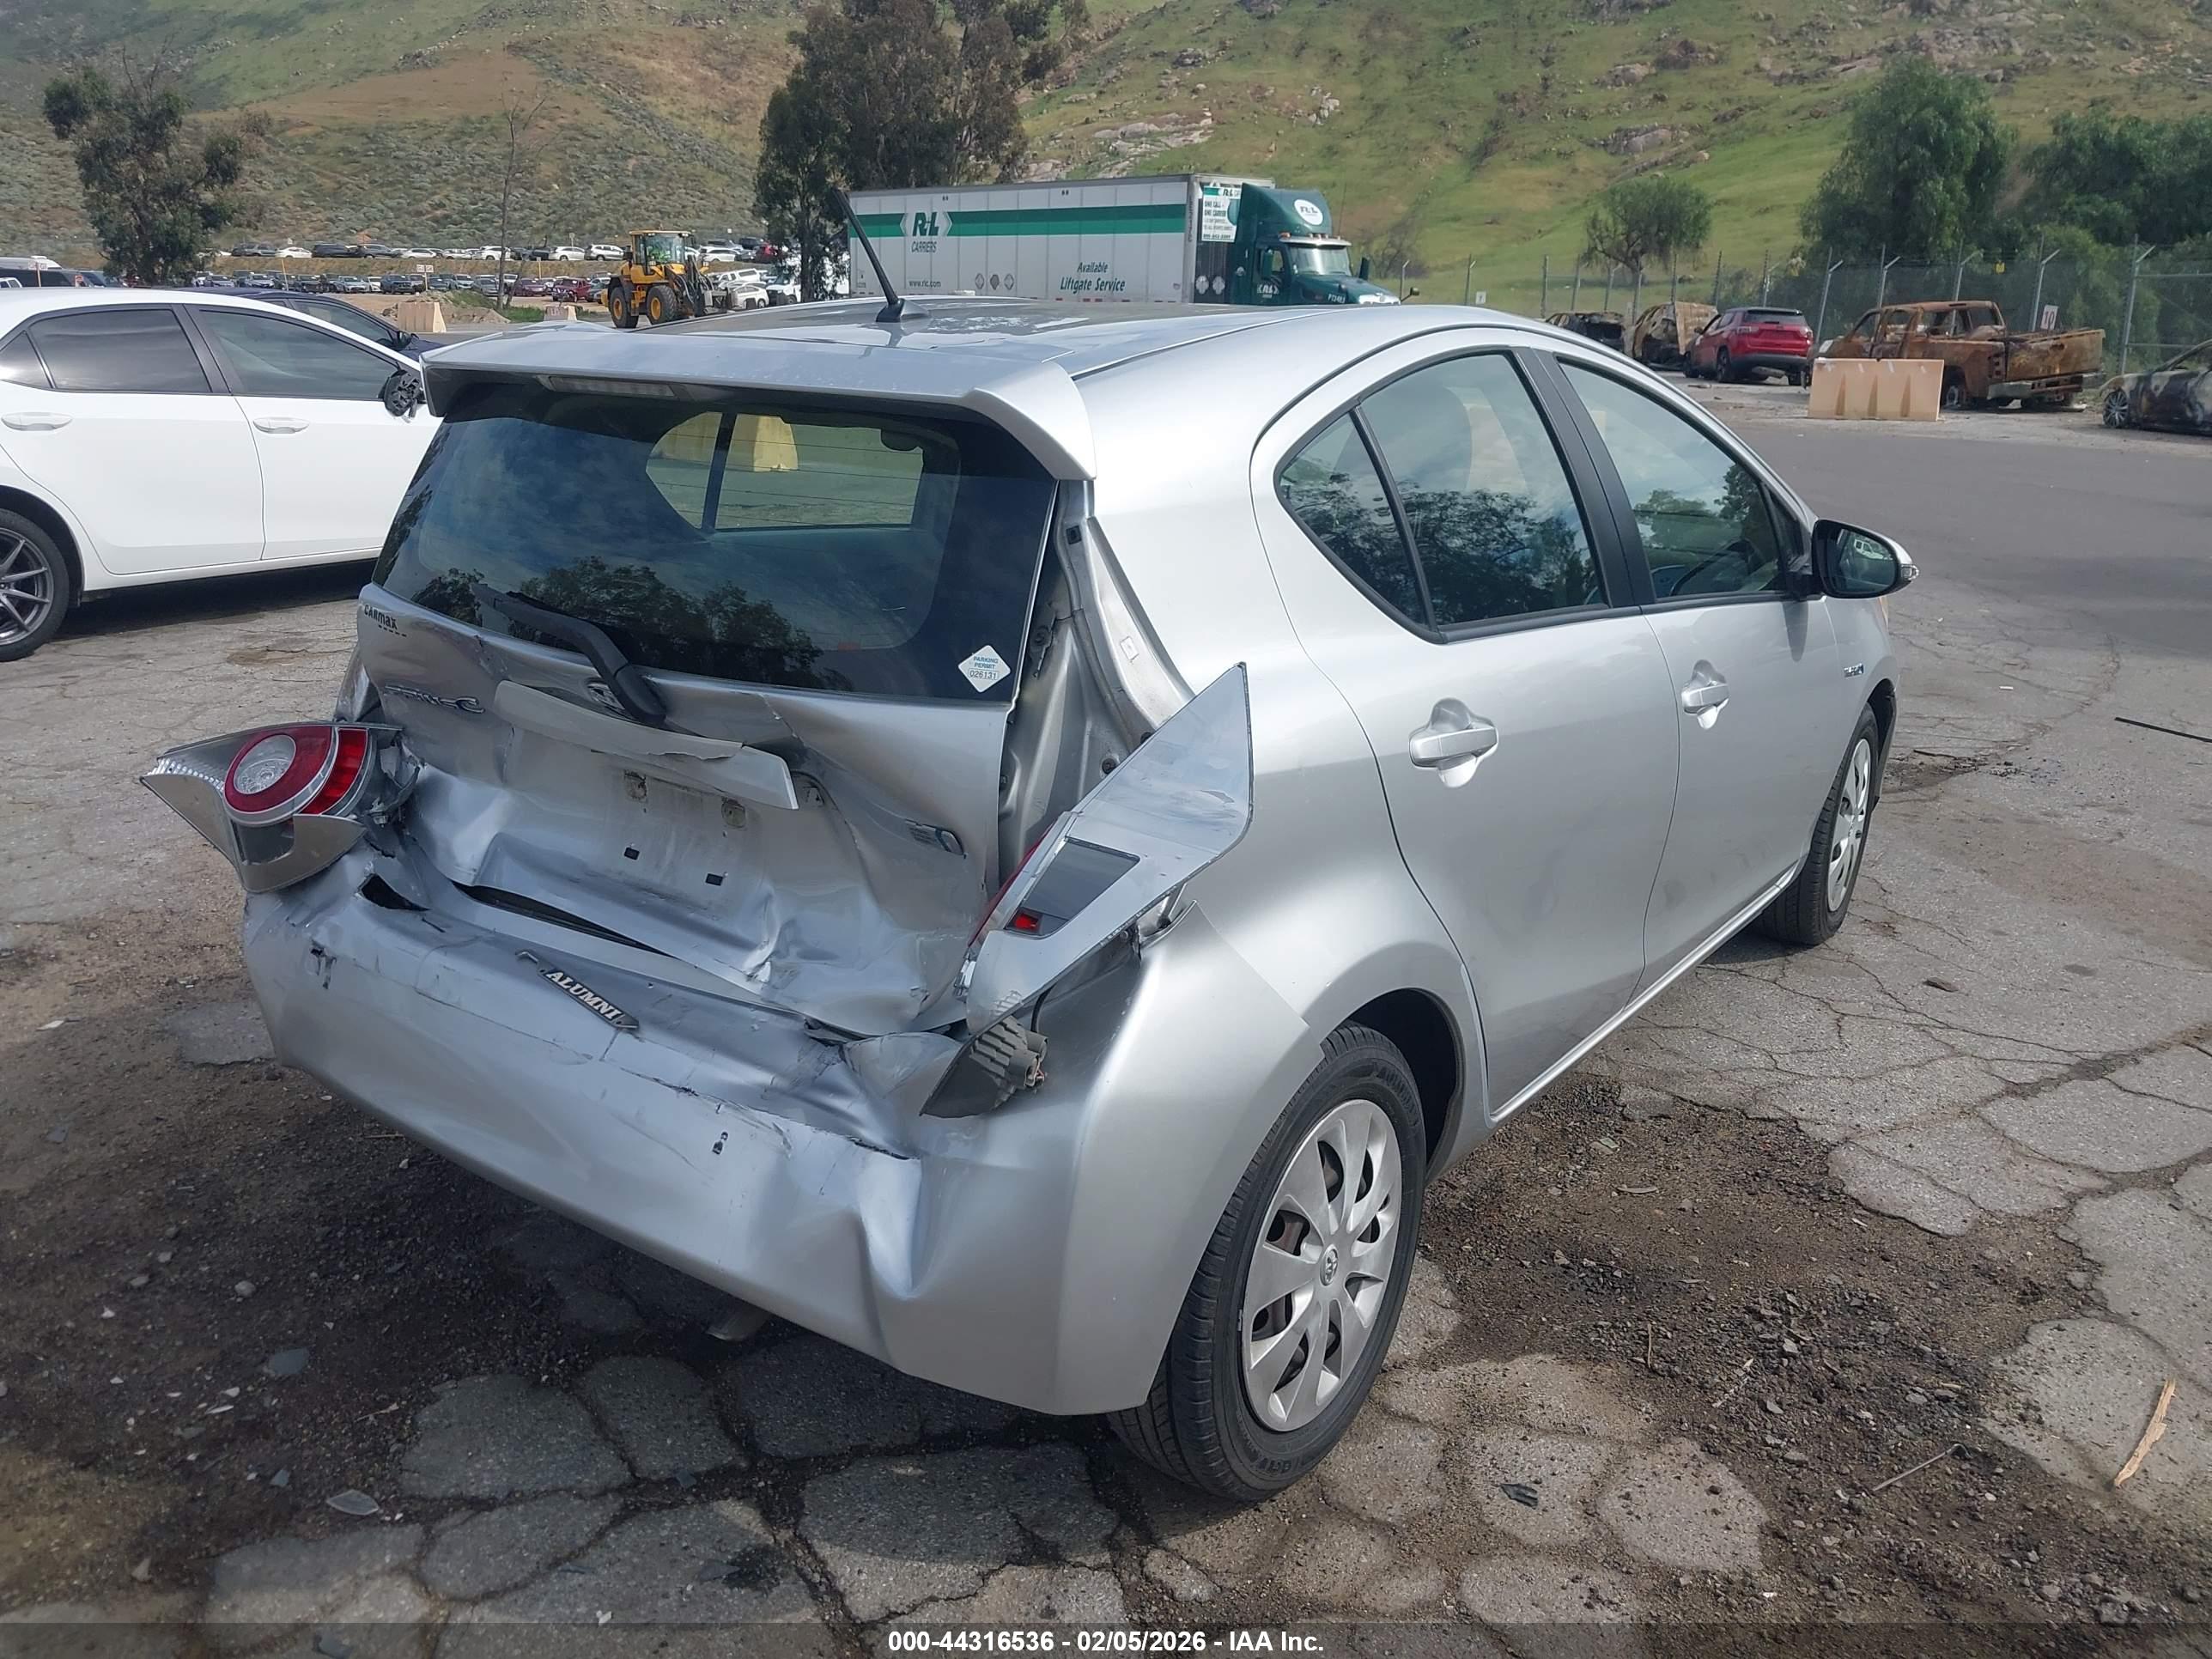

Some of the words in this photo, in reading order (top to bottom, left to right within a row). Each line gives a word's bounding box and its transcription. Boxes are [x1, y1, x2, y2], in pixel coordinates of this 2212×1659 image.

[911, 240, 937, 252] CARRIERS
[1077, 261, 1109, 273] Available
[1060, 276, 1092, 295] Liftgate
[1095, 276, 1126, 292] Service
[969, 670, 997, 680] 026131
[545, 971, 622, 1019] ALUMNI
